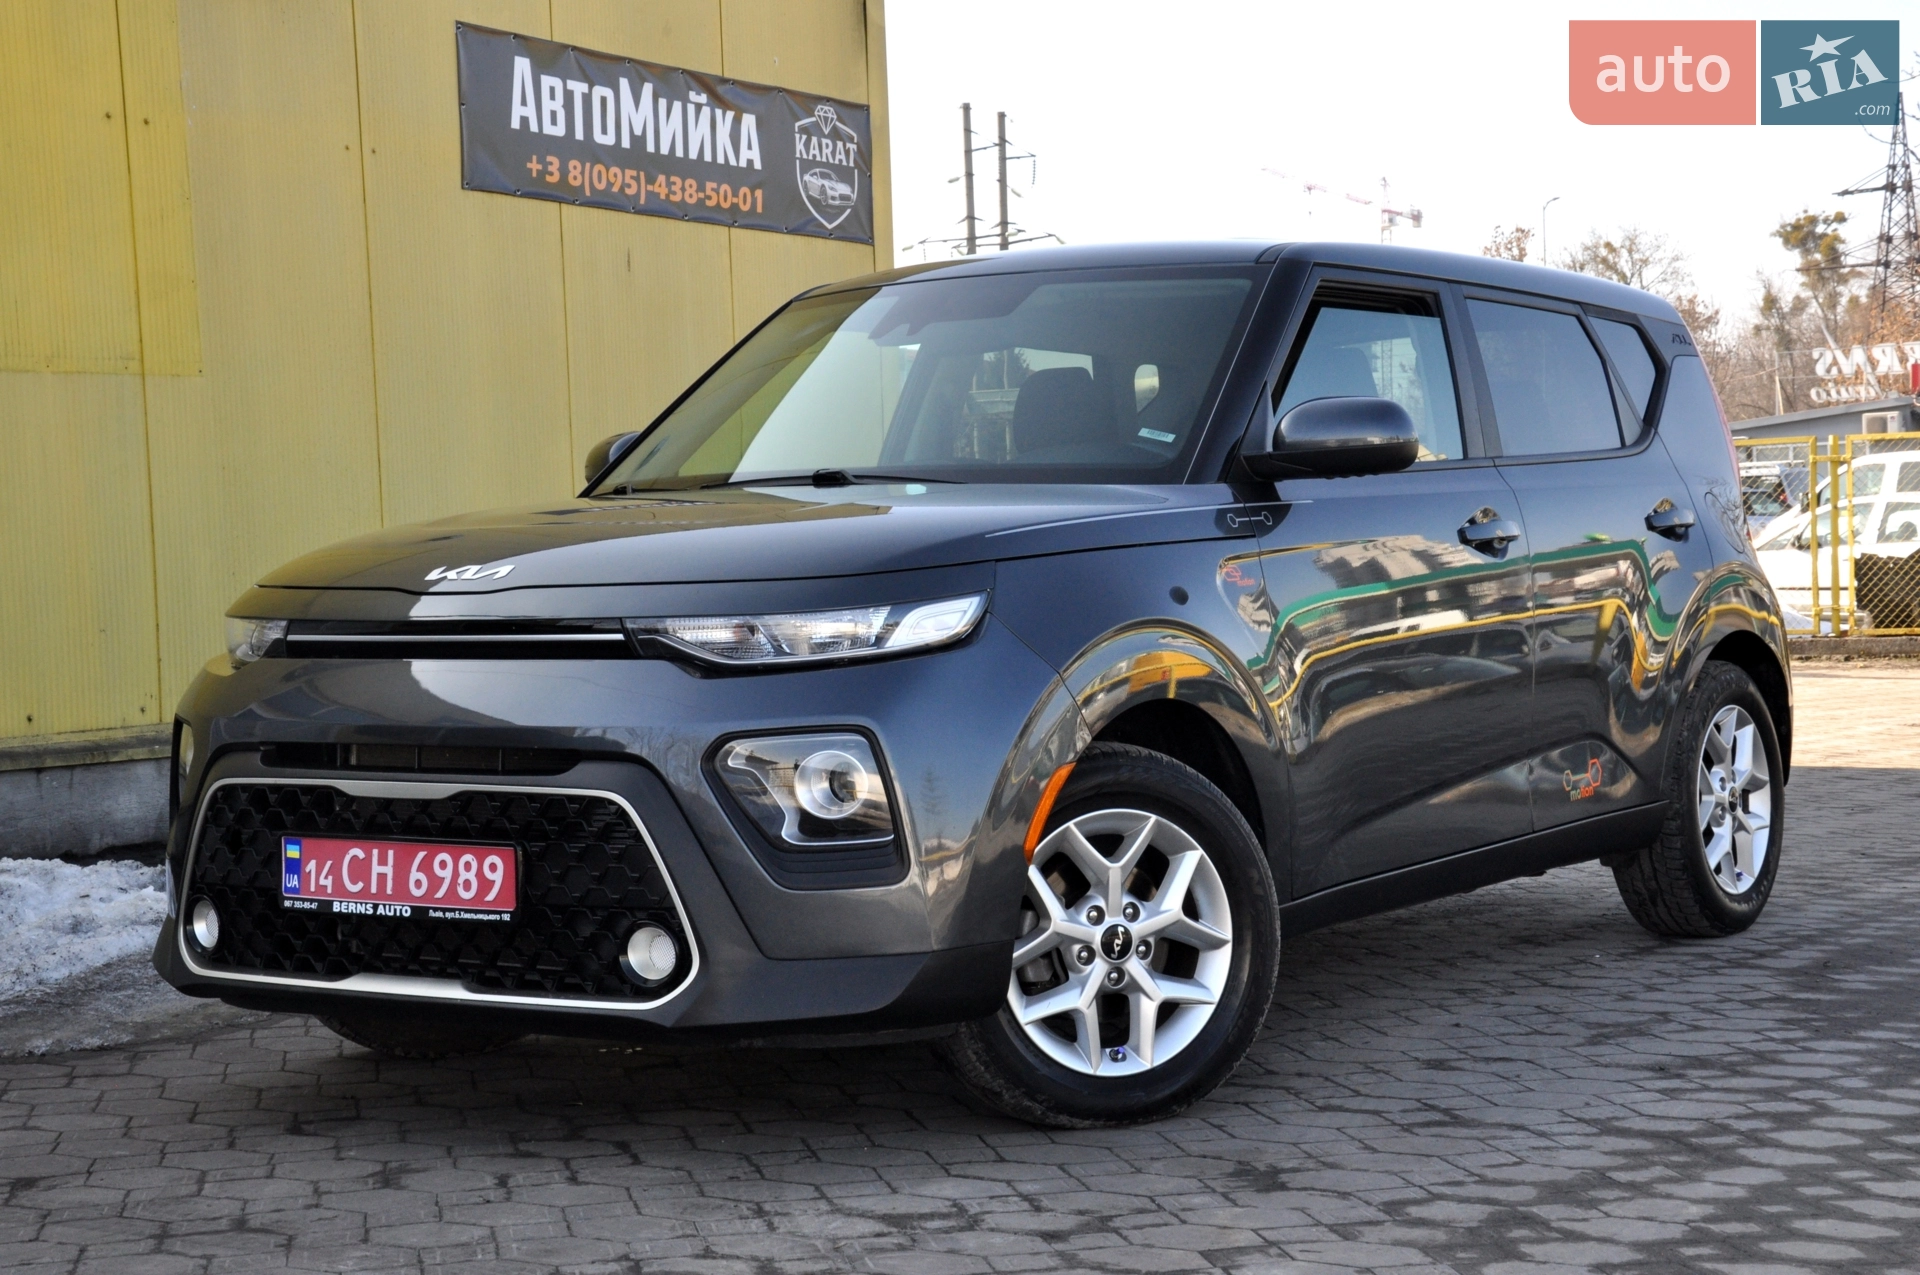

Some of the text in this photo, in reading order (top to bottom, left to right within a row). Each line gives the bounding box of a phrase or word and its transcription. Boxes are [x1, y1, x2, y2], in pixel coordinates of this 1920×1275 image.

[794, 133, 858, 167] KARAT
[526, 154, 763, 214] +3 8(095)-438-50-01
[285, 873, 299, 889] UA
[304, 859, 333, 894] 14
[408, 850, 505, 903] 6989
[332, 901, 412, 917] BERNS AUTO
